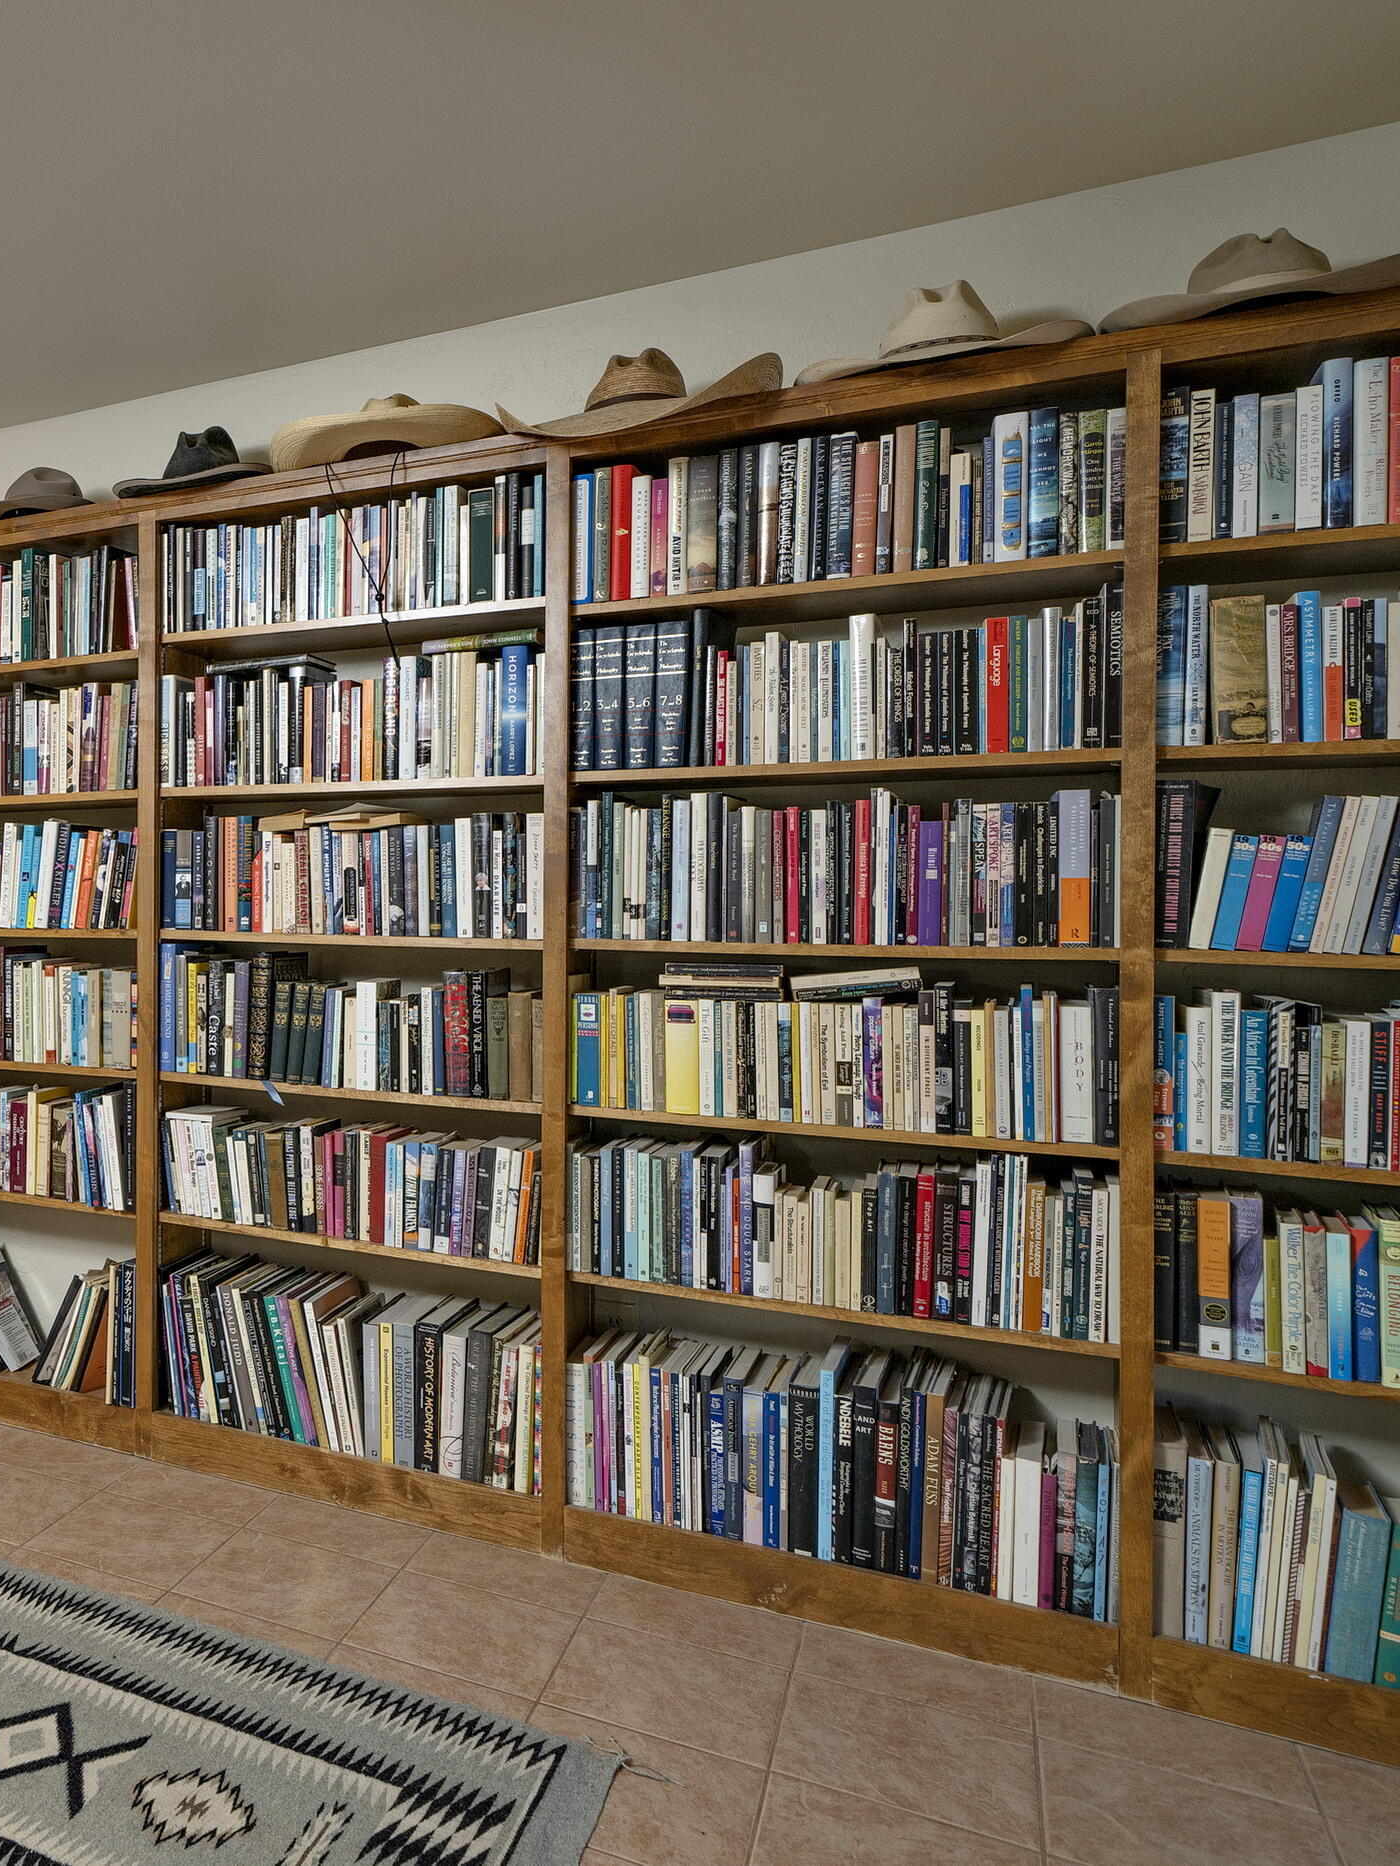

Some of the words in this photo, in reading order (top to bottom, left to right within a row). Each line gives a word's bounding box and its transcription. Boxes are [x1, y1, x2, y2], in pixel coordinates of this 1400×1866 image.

[1192, 395, 1211, 429] JOHN
[800, 447, 808, 468] TONI
[817, 444, 825, 462] IAN
[831, 446, 840, 471] ALAN
[839, 440, 852, 454] THE
[1063, 428, 1073, 469] MEMORY
[1192, 433, 1210, 473] BARTH
[744, 454, 752, 494] HAMNET
[1062, 472, 1072, 496] WALL
[1238, 462, 1252, 492] GAIN
[829, 476, 839, 552] HOLLINGHURST
[672, 536, 680, 555] AYAD
[672, 557, 681, 582] AKHTAR
[1192, 611, 1201, 636] NORTH
[1304, 599, 1315, 664] ASYMMETRY
[1088, 631, 1096, 652] THEORY
[1110, 611, 1121, 676] SEMIOTICS
[1192, 638, 1200, 664] WATER
[1284, 635, 1294, 671] BRIDGE
[990, 645, 1003, 686] Language
[508, 655, 516, 713] HORIZON
[1088, 666, 1096, 696] SEMIOTICS
[1349, 701, 1357, 722] USED
[662, 800, 670, 838] STRANGE
[989, 820, 998, 839] ART
[56, 827, 68, 862] INDIAN
[974, 842, 984, 873] SPEAK
[989, 841, 998, 872] SPOKE
[52, 872, 64, 907] KILLER
[472, 975, 481, 991] THE
[702, 1007, 710, 1024] The
[839, 1006, 848, 1028] Feeling
[1221, 1000, 1234, 1016] THE
[1246, 1016, 1258, 1029] An
[208, 1015, 220, 1056] Caste
[702, 1027, 710, 1043] Gift
[840, 1030, 848, 1041] And
[1221, 1018, 1234, 1045] TOWER
[1246, 1031, 1259, 1056] African
[1196, 1037, 1204, 1067] Gawande
[1221, 1047, 1234, 1063] AND
[1331, 1030, 1339, 1066] DISRAELI
[1374, 1031, 1386, 1062] STIFF
[1221, 1065, 1233, 1080] THE
[1245, 1067, 1259, 1103] Greenland
[1194, 1079, 1204, 1098] Being
[1220, 1082, 1234, 1110] BRIDGE
[1196, 1100, 1204, 1124] Mortal
[743, 1217, 751, 1244] DOUG
[942, 1204, 952, 1276] STRUCTURES
[1287, 1227, 1300, 1259] Walker
[743, 1251, 751, 1283] STARN
[1095, 1249, 1103, 1282] NATURAL
[1287, 1262, 1301, 1278] The
[1094, 1284, 1102, 1299] WAY
[1094, 1300, 1101, 1309] TO
[1287, 1281, 1301, 1308] Color
[184, 1312, 194, 1333] DAVID
[222, 1292, 236, 1334] DONALD
[231, 1338, 242, 1366] JUDD
[1093, 1310, 1101, 1332] DRAW
[1285, 1311, 1301, 1342] Purple
[188, 1334, 196, 1352] PARK
[395, 1346, 402, 1358] OF
[424, 1337, 433, 1379] HISTORY
[404, 1355, 412, 1396] WORLD
[425, 1383, 432, 1395] OF
[395, 1361, 403, 1439] PHOTOGRAPHY
[901, 1396, 910, 1421] ANDY
[404, 1398, 412, 1441] HISTORY
[424, 1397, 432, 1439] MODERN
[794, 1401, 803, 1461] MYTHOLOGY
[805, 1414, 814, 1450] WORLD
[839, 1400, 851, 1446] NDEBELE
[854, 1414, 875, 1423] LAND
[856, 1426, 871, 1434] ART
[424, 1440, 432, 1461] ART
[711, 1420, 722, 1453] ASMP
[879, 1425, 892, 1465] BARNS
[899, 1423, 910, 1490] GOLDSWORTHY
[927, 1435, 938, 1471] ADAM
[982, 1459, 992, 1481] THE
[926, 1476, 938, 1505] FUSS
[944, 1478, 952, 1492] Tom
[943, 1493, 952, 1523] Friedman
[981, 1484, 991, 1527] SACRED
[979, 1531, 990, 1568] HEART
